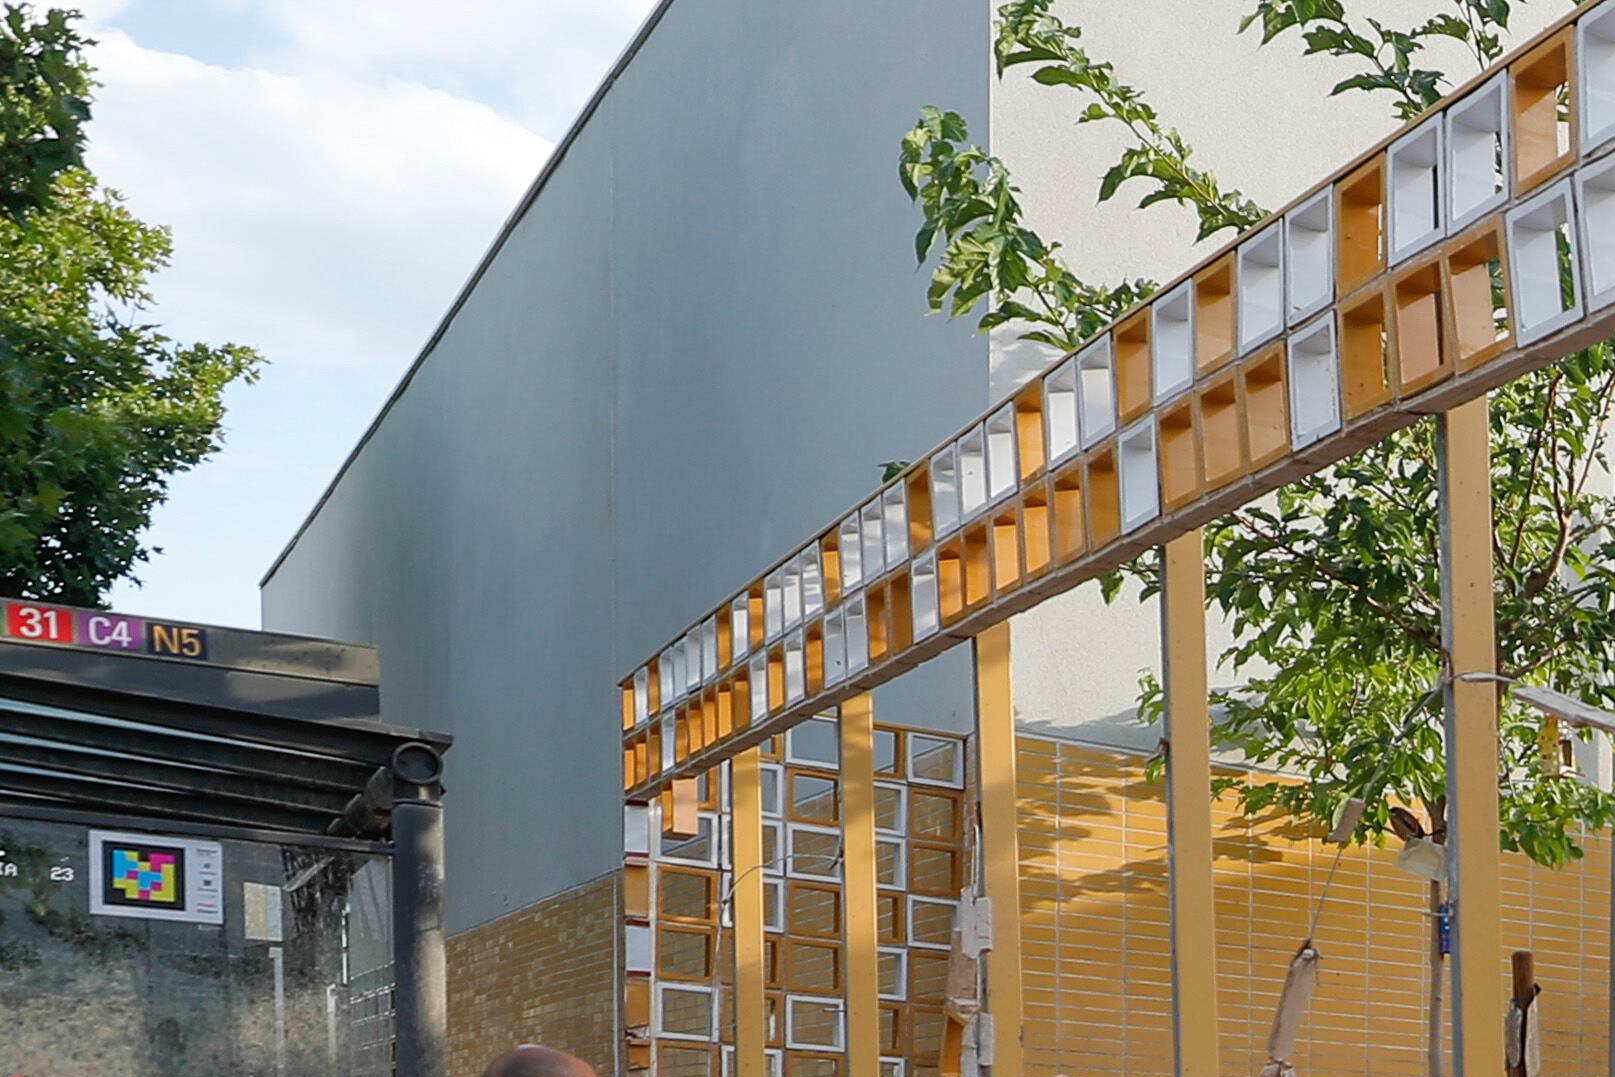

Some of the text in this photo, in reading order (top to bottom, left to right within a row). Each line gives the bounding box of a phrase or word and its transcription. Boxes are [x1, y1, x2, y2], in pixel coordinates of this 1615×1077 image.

[18, 607, 202, 657] 31 C4 N5
[49, 866, 75, 882] 23
